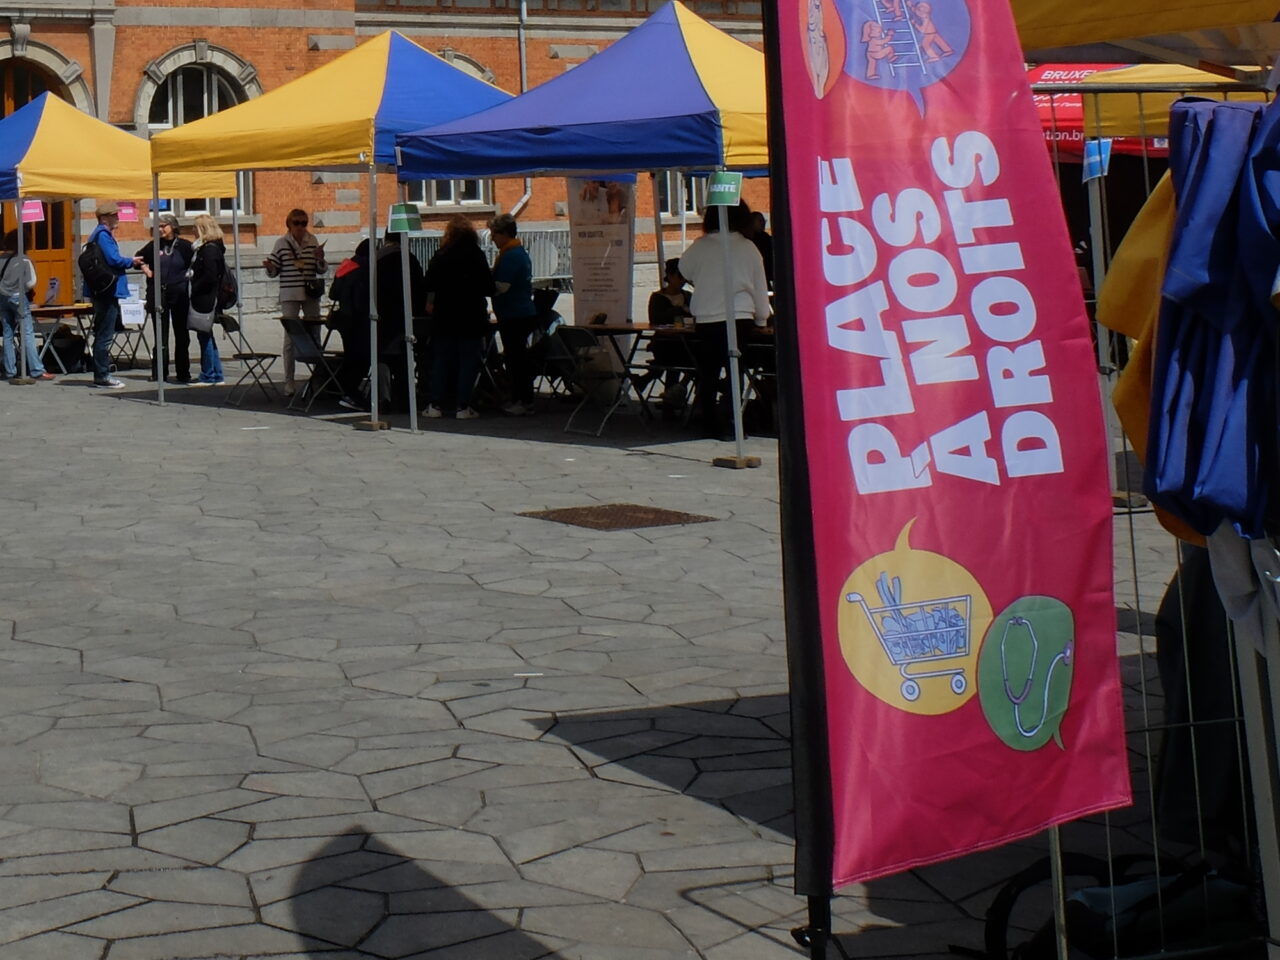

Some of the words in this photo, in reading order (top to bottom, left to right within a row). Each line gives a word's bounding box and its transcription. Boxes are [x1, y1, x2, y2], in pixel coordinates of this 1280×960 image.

[1041, 70, 1097, 80] BRUXE
[817, 156, 932, 494] PLACE
[871, 187, 980, 385] NOS
[931, 130, 1065, 477] DROITS
